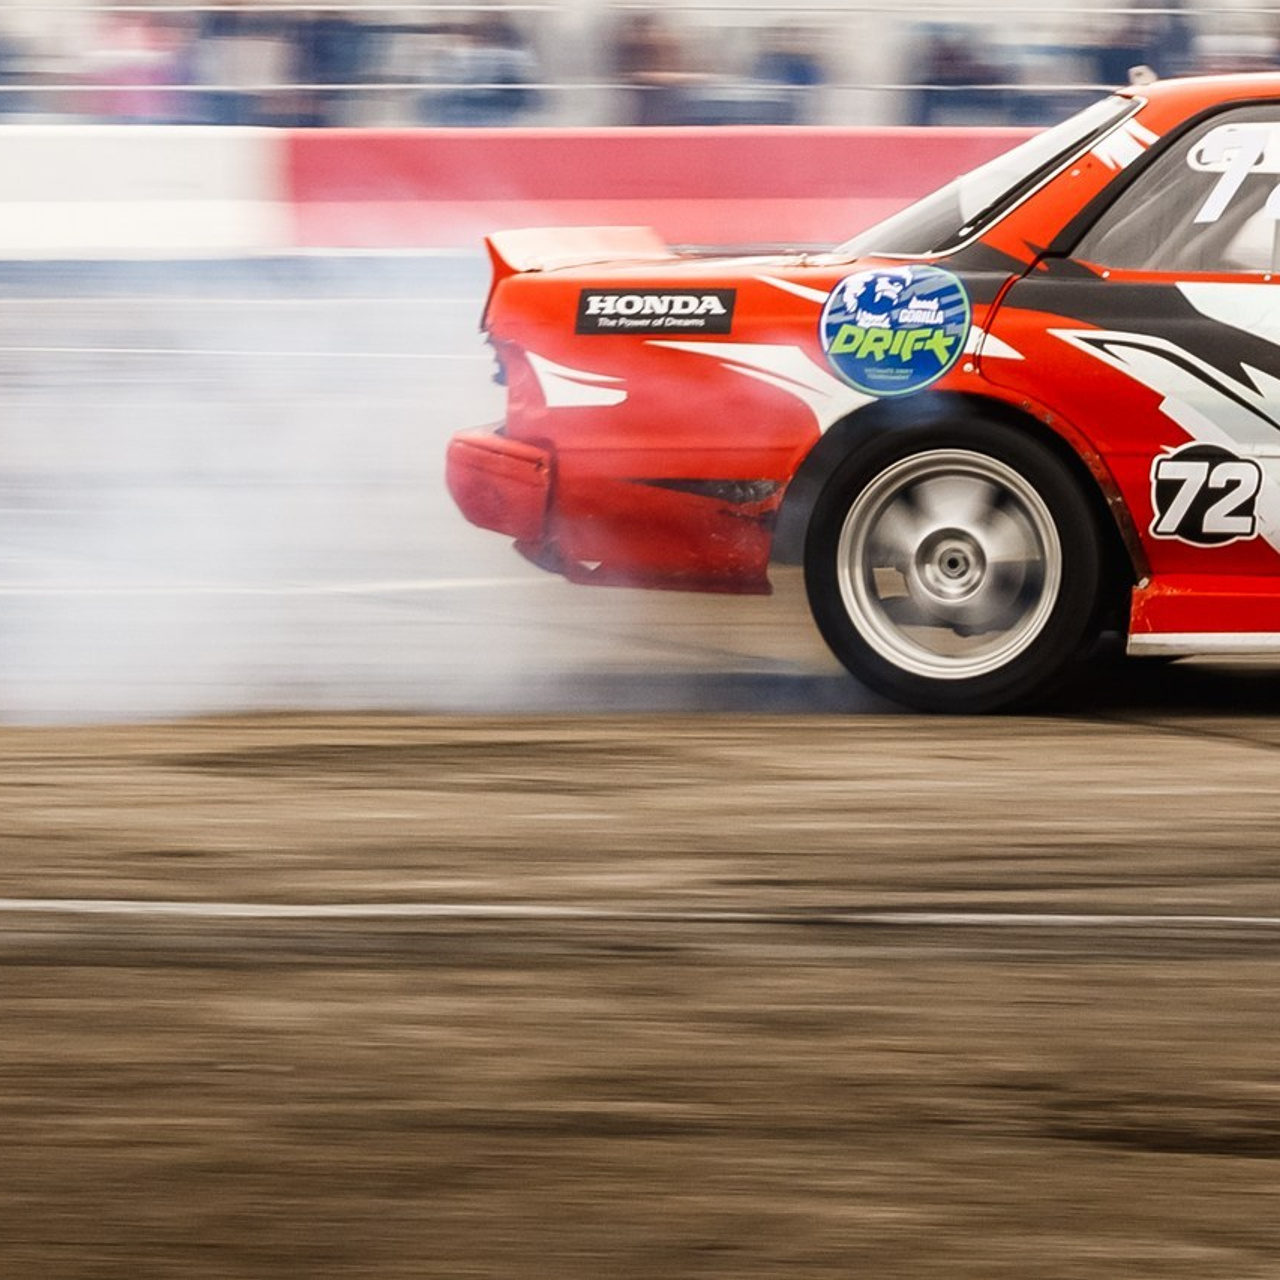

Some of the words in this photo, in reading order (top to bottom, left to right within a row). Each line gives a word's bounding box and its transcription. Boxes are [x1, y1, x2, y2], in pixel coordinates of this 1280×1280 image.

[585, 294, 728, 315] HONDA
[597, 317, 617, 328] The
[652, 316, 665, 328] of
[898, 308, 945, 325] GORILLA
[828, 323, 956, 366] DRIFT
[1156, 461, 1260, 534] 72
